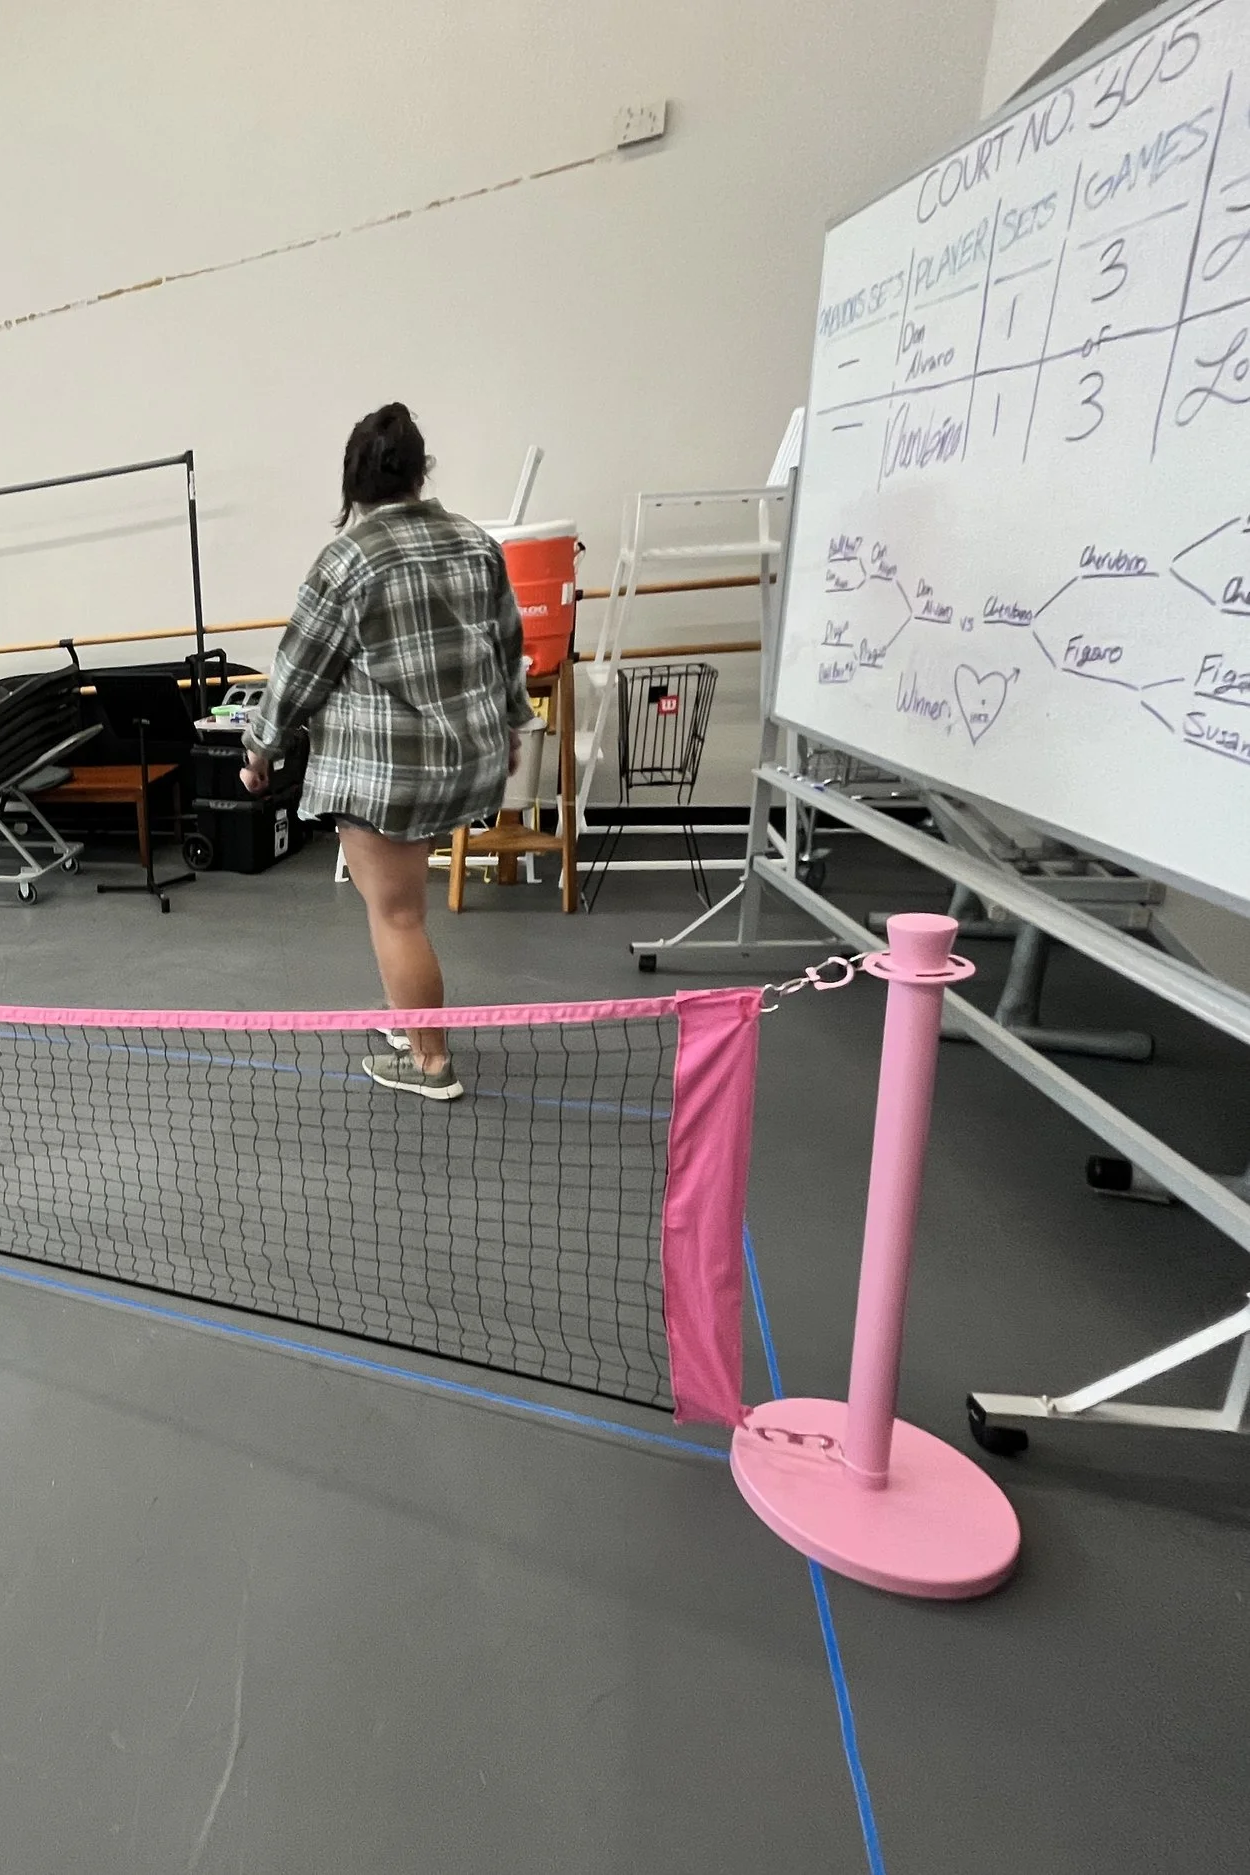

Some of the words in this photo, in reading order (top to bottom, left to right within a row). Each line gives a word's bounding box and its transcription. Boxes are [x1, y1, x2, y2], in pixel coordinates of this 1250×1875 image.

[916, 125, 1014, 224] COURT
[1085, 106, 1215, 209] GAMES
[914, 217, 989, 296] PLAYER
[1091, 237, 1129, 303] 3
[1064, 370, 1105, 442] 3
